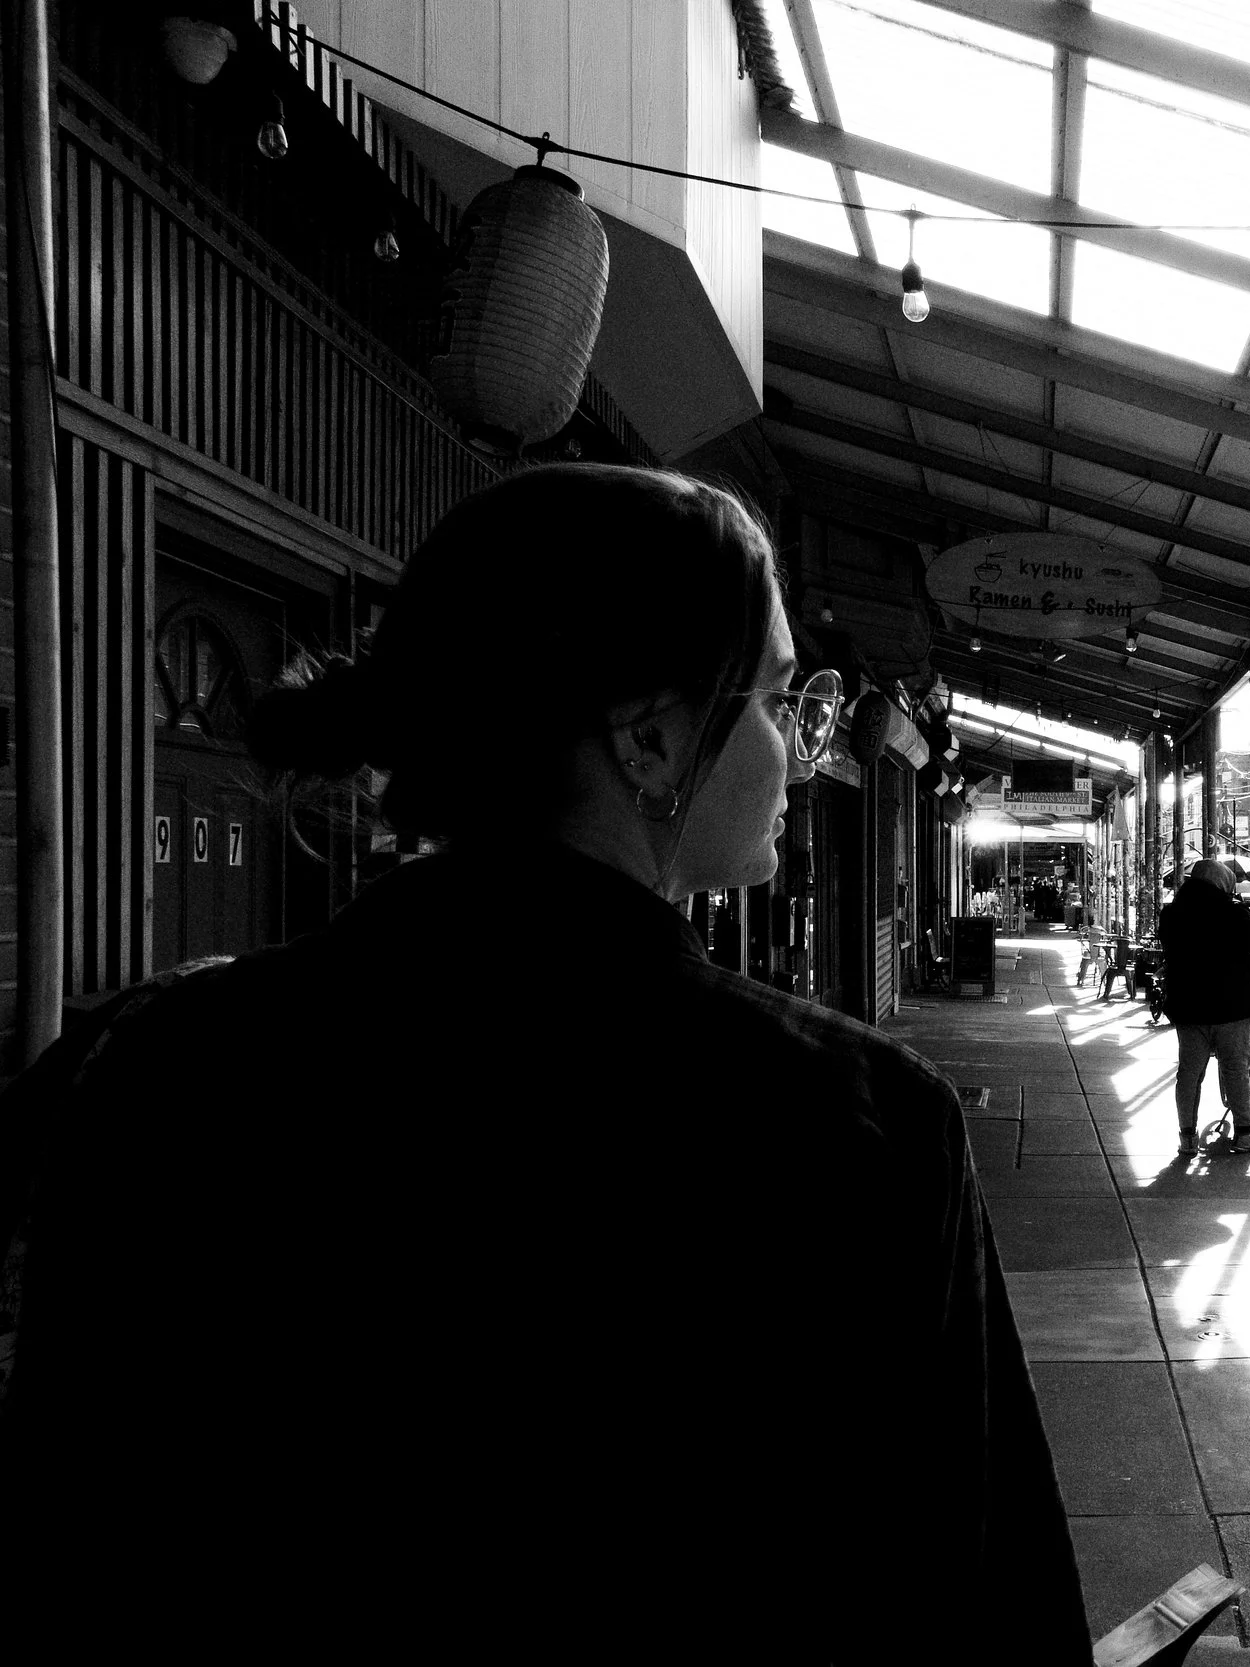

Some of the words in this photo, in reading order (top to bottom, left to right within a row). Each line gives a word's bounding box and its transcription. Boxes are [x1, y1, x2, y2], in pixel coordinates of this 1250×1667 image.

[1019, 558, 1083, 580] kyushu
[969, 585, 1032, 610] Ramen
[1085, 597, 1132, 618] Sushi
[1003, 804, 1089, 812] PHILADELPHIA
